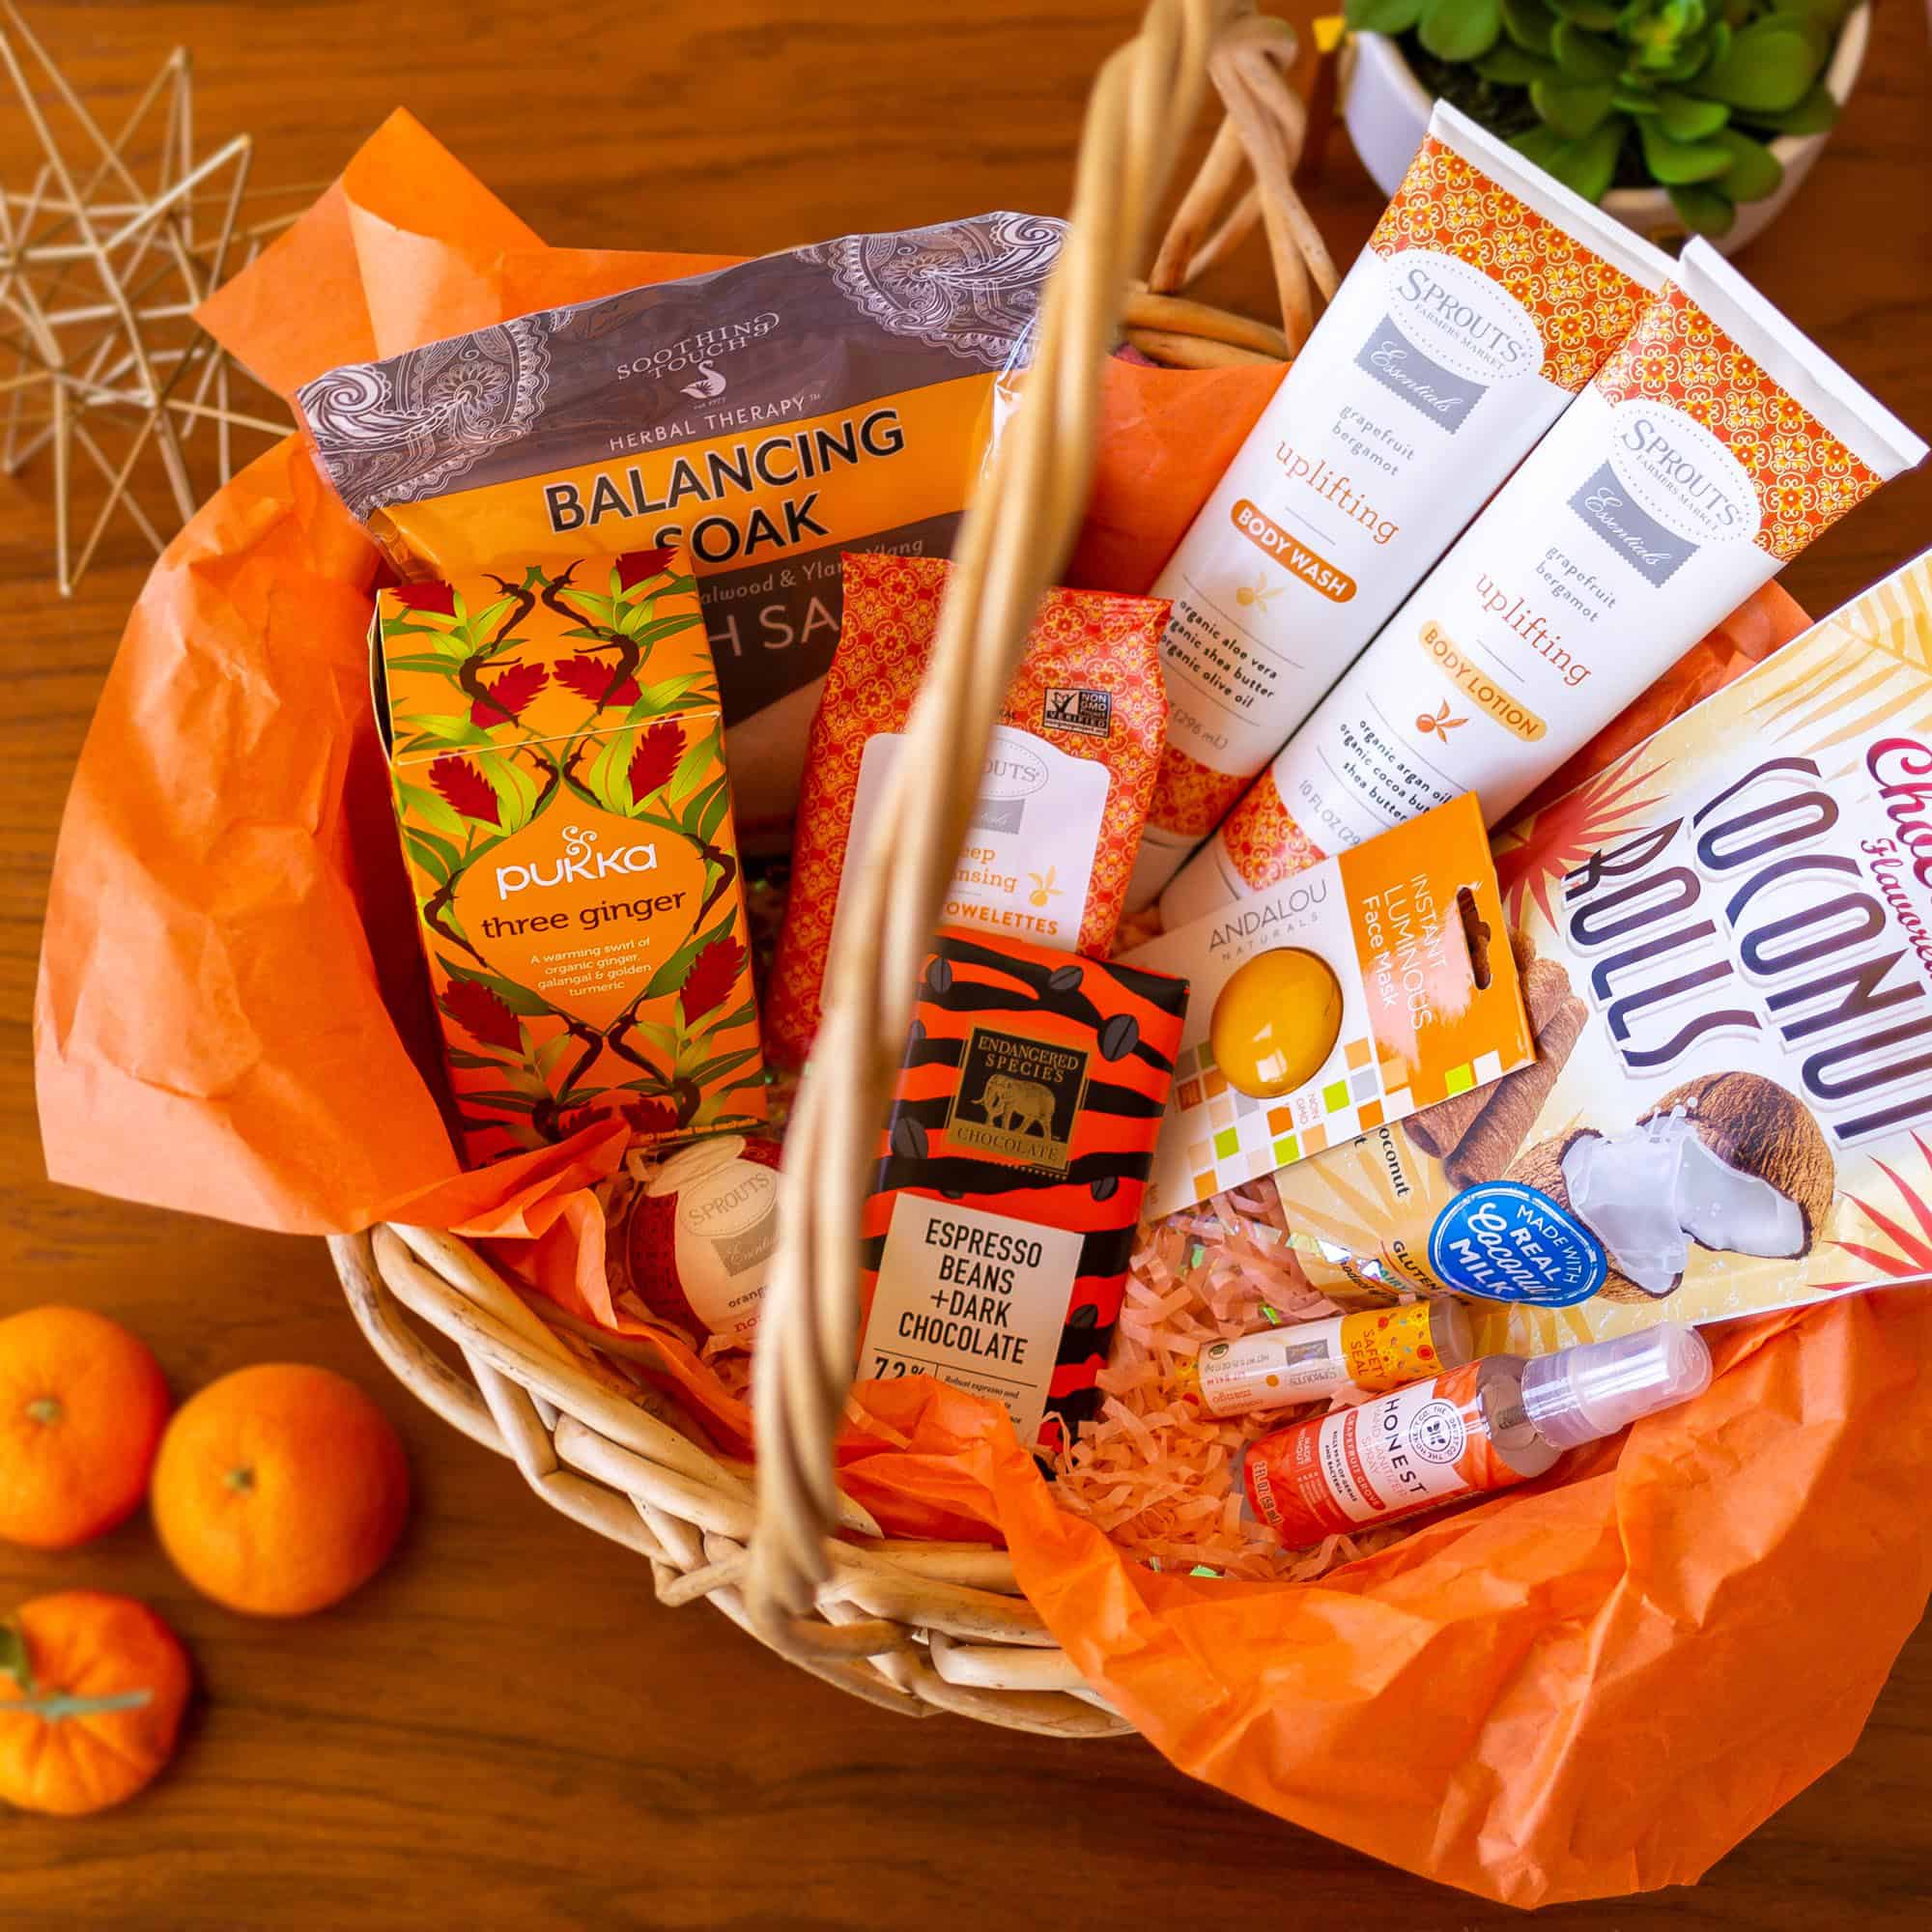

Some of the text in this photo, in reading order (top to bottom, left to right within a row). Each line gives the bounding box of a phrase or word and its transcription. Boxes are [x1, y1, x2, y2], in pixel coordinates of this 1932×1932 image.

[617, 312, 781, 381] SOOTHING
[1397, 269, 1523, 363] SPROUTS
[1415, 303, 1507, 371] FARMERS MARKET
[649, 334, 747, 380] TOUCH
[1371, 340, 1463, 412] Essentials
[610, 419, 696, 451] HERBAL
[1331, 421, 1400, 477] bergamot
[1340, 403, 1416, 461] grapefruit
[544, 409, 904, 533] BALANCING
[1275, 440, 1400, 546] uplifting
[1622, 419, 1740, 526] SPROUTS
[1636, 454, 1719, 531] FARMERS MARKET
[655, 491, 829, 563] SOAK
[1237, 506, 1347, 597] BODY WASH
[1584, 487, 1672, 565] Essentials
[700, 575, 773, 605] alwood
[781, 570, 797, 587] &
[1535, 561, 1600, 623] bergamot
[1544, 544, 1618, 610] grapefruit
[758, 596, 840, 650] SA
[1179, 601, 1277, 680] organic aloe vera
[1475, 573, 1591, 688] uplifting
[1162, 634, 1255, 708] organic olive oil
[1170, 616, 1275, 698] ganic shea butter
[1423, 628, 1539, 737] BODY LOTION
[1340, 724, 1431, 813] organic cocoa but
[1344, 762, 1407, 821] shea butter
[1359, 721, 1453, 804] organic argan oil
[1309, 793, 1322, 813] FL
[1321, 810, 1341, 827] OZ
[1338, 826, 1360, 845] (29
[496, 829, 658, 900] pukka
[956, 868, 1018, 893] nsing
[481, 892, 687, 939] three ginger
[946, 900, 1059, 936] OWELETTES
[1208, 879, 1327, 952] ANDALOU
[1221, 913, 1320, 960] NATURALS
[1410, 873, 1446, 967] INSTANT
[1861, 838, 1932, 980] Flavore
[530, 937, 650, 964] A warming swirl of
[545, 961, 593, 975] organic
[1362, 895, 1400, 1007] Face Mask
[1383, 885, 1433, 1031] LUMINOUS
[1565, 816, 1763, 1068] ROLLS
[538, 973, 591, 989] galangal
[608, 964, 651, 980] golden
[570, 980, 625, 996] turmeric
[978, 1036, 1078, 1070] ENDANGERED
[986, 1053, 1065, 1082] SPECIES
[957, 1128, 1058, 1160] CHOCOLATE
[1378, 1126, 1411, 1197] oconut
[688, 1173, 770, 1226] SPROUTS
[925, 1218, 1042, 1268] ESPRESSO
[939, 1255, 1014, 1294] BEANS
[1393, 1240, 1441, 1292] GLUTEN
[1449, 1237, 1515, 1294] MILK
[1467, 1203, 1561, 1294] Coconut
[1510, 1227, 1562, 1281] REAL
[1517, 1205, 1581, 1284] MADE WITH
[898, 1312, 1028, 1365] CHOCOLATE
[930, 1290, 1012, 1328] +DARK
[1350, 1341, 1370, 1377] SEAL
[1364, 1329, 1386, 1379] SAFETY
[1383, 1398, 1430, 1493] HONEST
